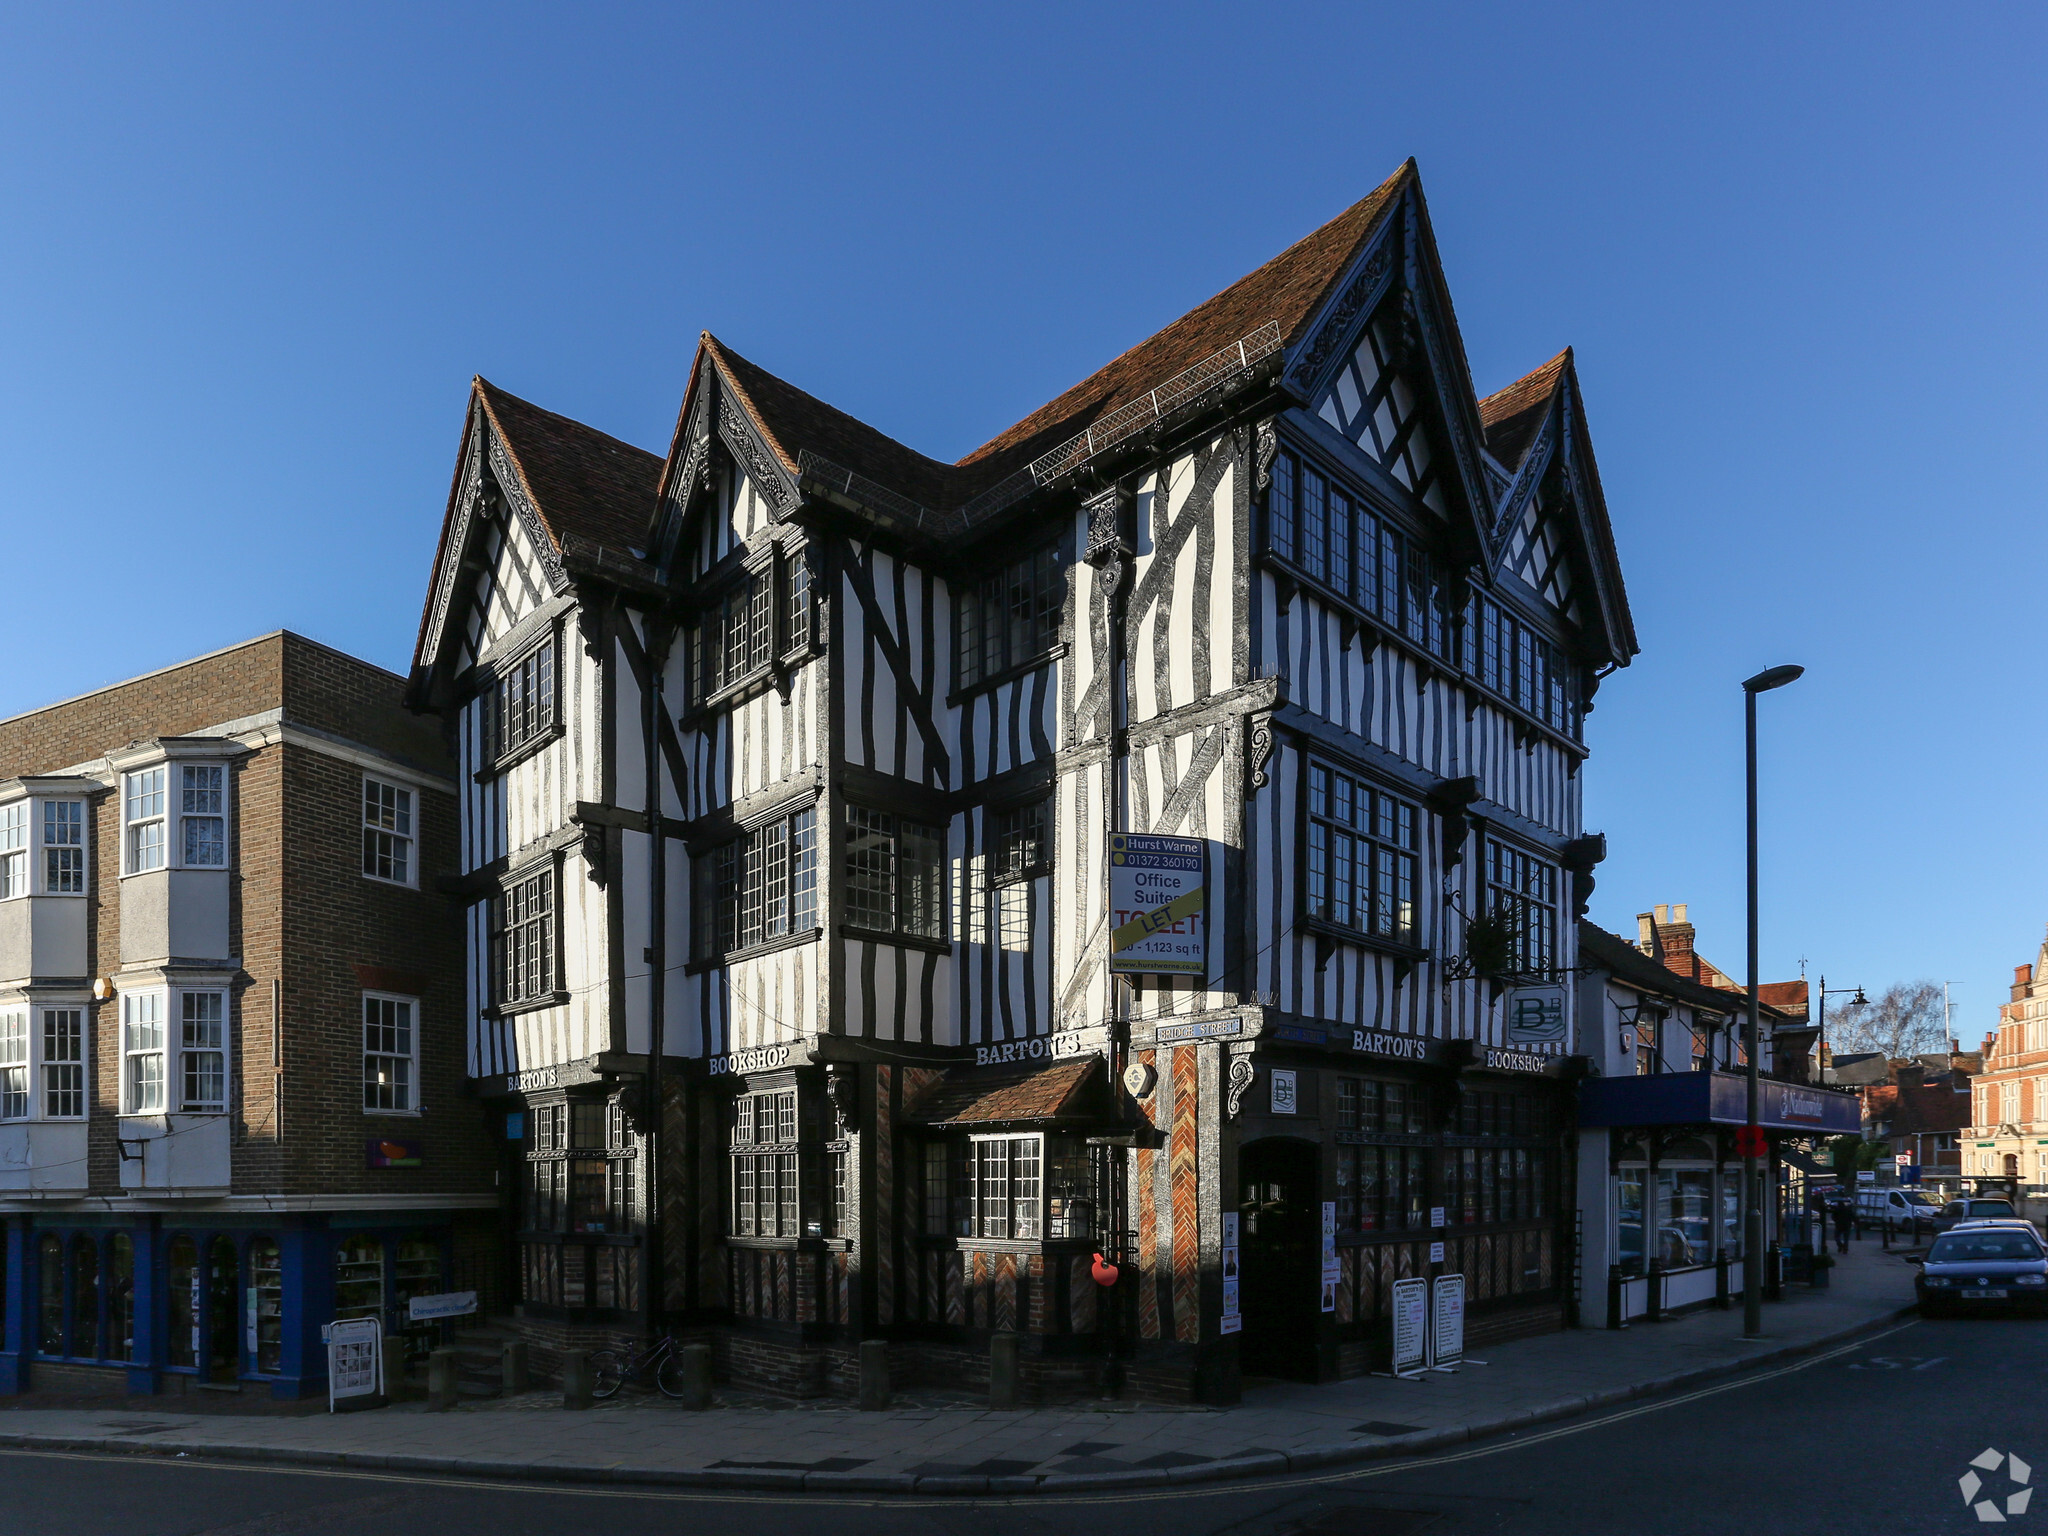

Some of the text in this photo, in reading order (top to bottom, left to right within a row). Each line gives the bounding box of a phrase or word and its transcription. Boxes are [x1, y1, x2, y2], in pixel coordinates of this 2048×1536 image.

[1128, 838, 1198, 853] Hurst Warne
[1128, 854, 1197, 870] 01372 360190
[1135, 872, 1181, 888] Office
[1141, 907, 1172, 933] LET
[1145, 942, 1172, 954] 1,123
[1175, 944, 1189, 956] sq
[1192, 943, 1200, 955] ft
[1115, 960, 1201, 971] www.hurstwarne.co.uk
[1160, 1021, 1236, 1040] BRIDGE STREET
[976, 1034, 1081, 1066] BARTON'S
[1352, 1030, 1426, 1060] BARTON'S
[709, 1046, 790, 1076] BOOKSHOP
[1487, 1050, 1545, 1073] BOOKSHOP
[507, 1069, 558, 1092] BARTON'S
[413, 1305, 450, 1316] Chiropractic
